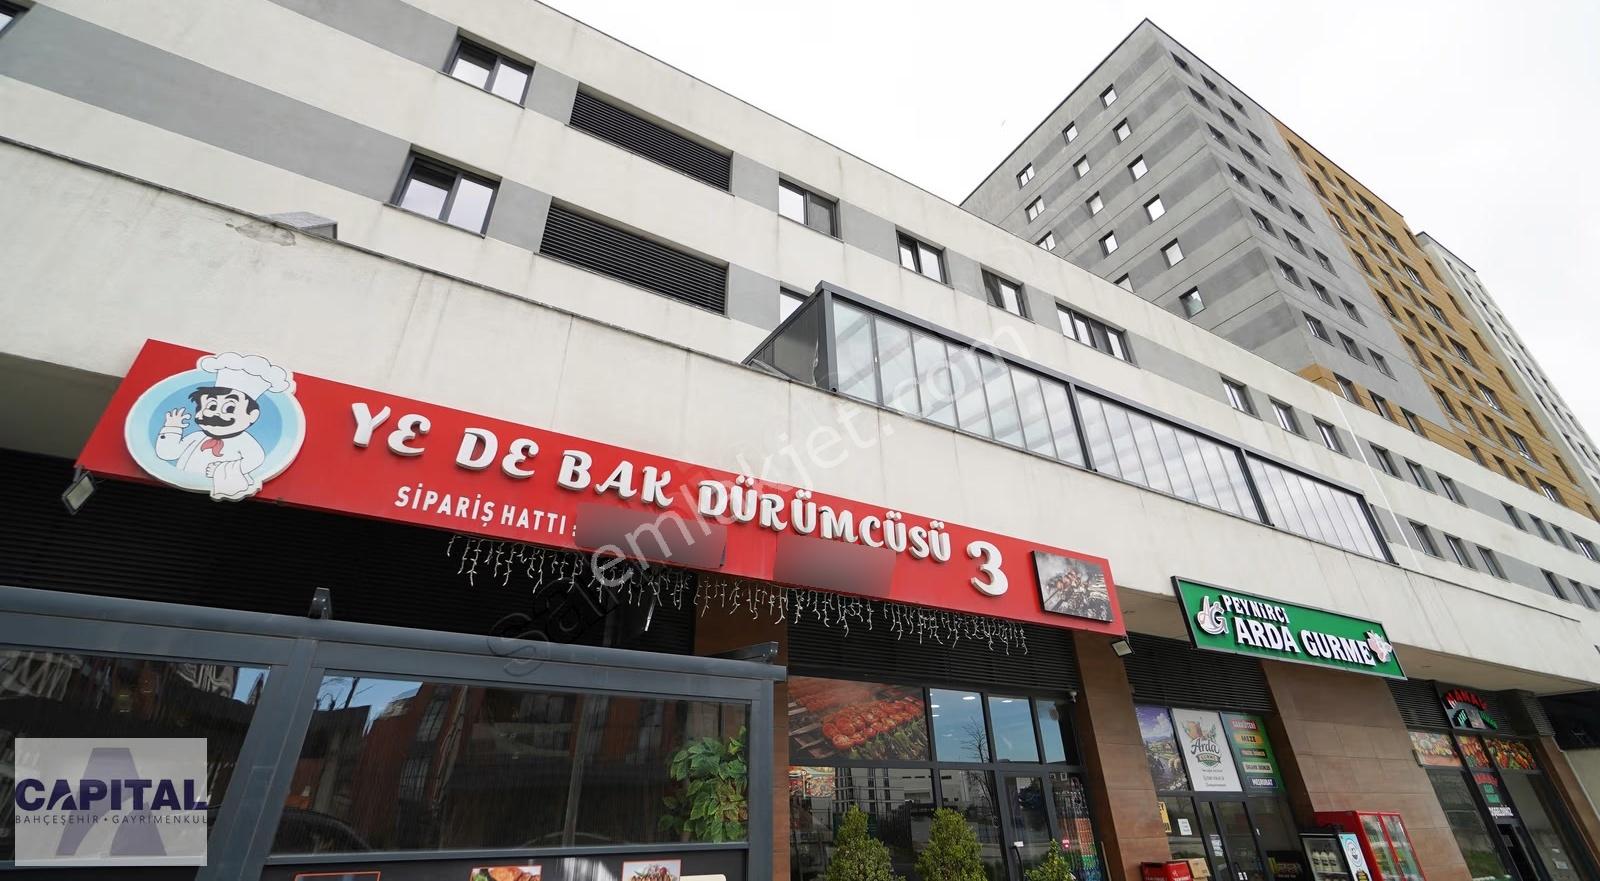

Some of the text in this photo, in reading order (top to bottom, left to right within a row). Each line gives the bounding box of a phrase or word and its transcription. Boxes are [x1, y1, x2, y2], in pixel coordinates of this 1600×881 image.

[351, 402, 1009, 596] YE DE BAK DÜRÜMCÜSÜ 3
[395, 482, 494, 527] SİPARİŞ
[500, 504, 566, 535] HATTI
[1234, 616, 1376, 666] ARDA GURME
[1191, 739, 1220, 755] Arda
